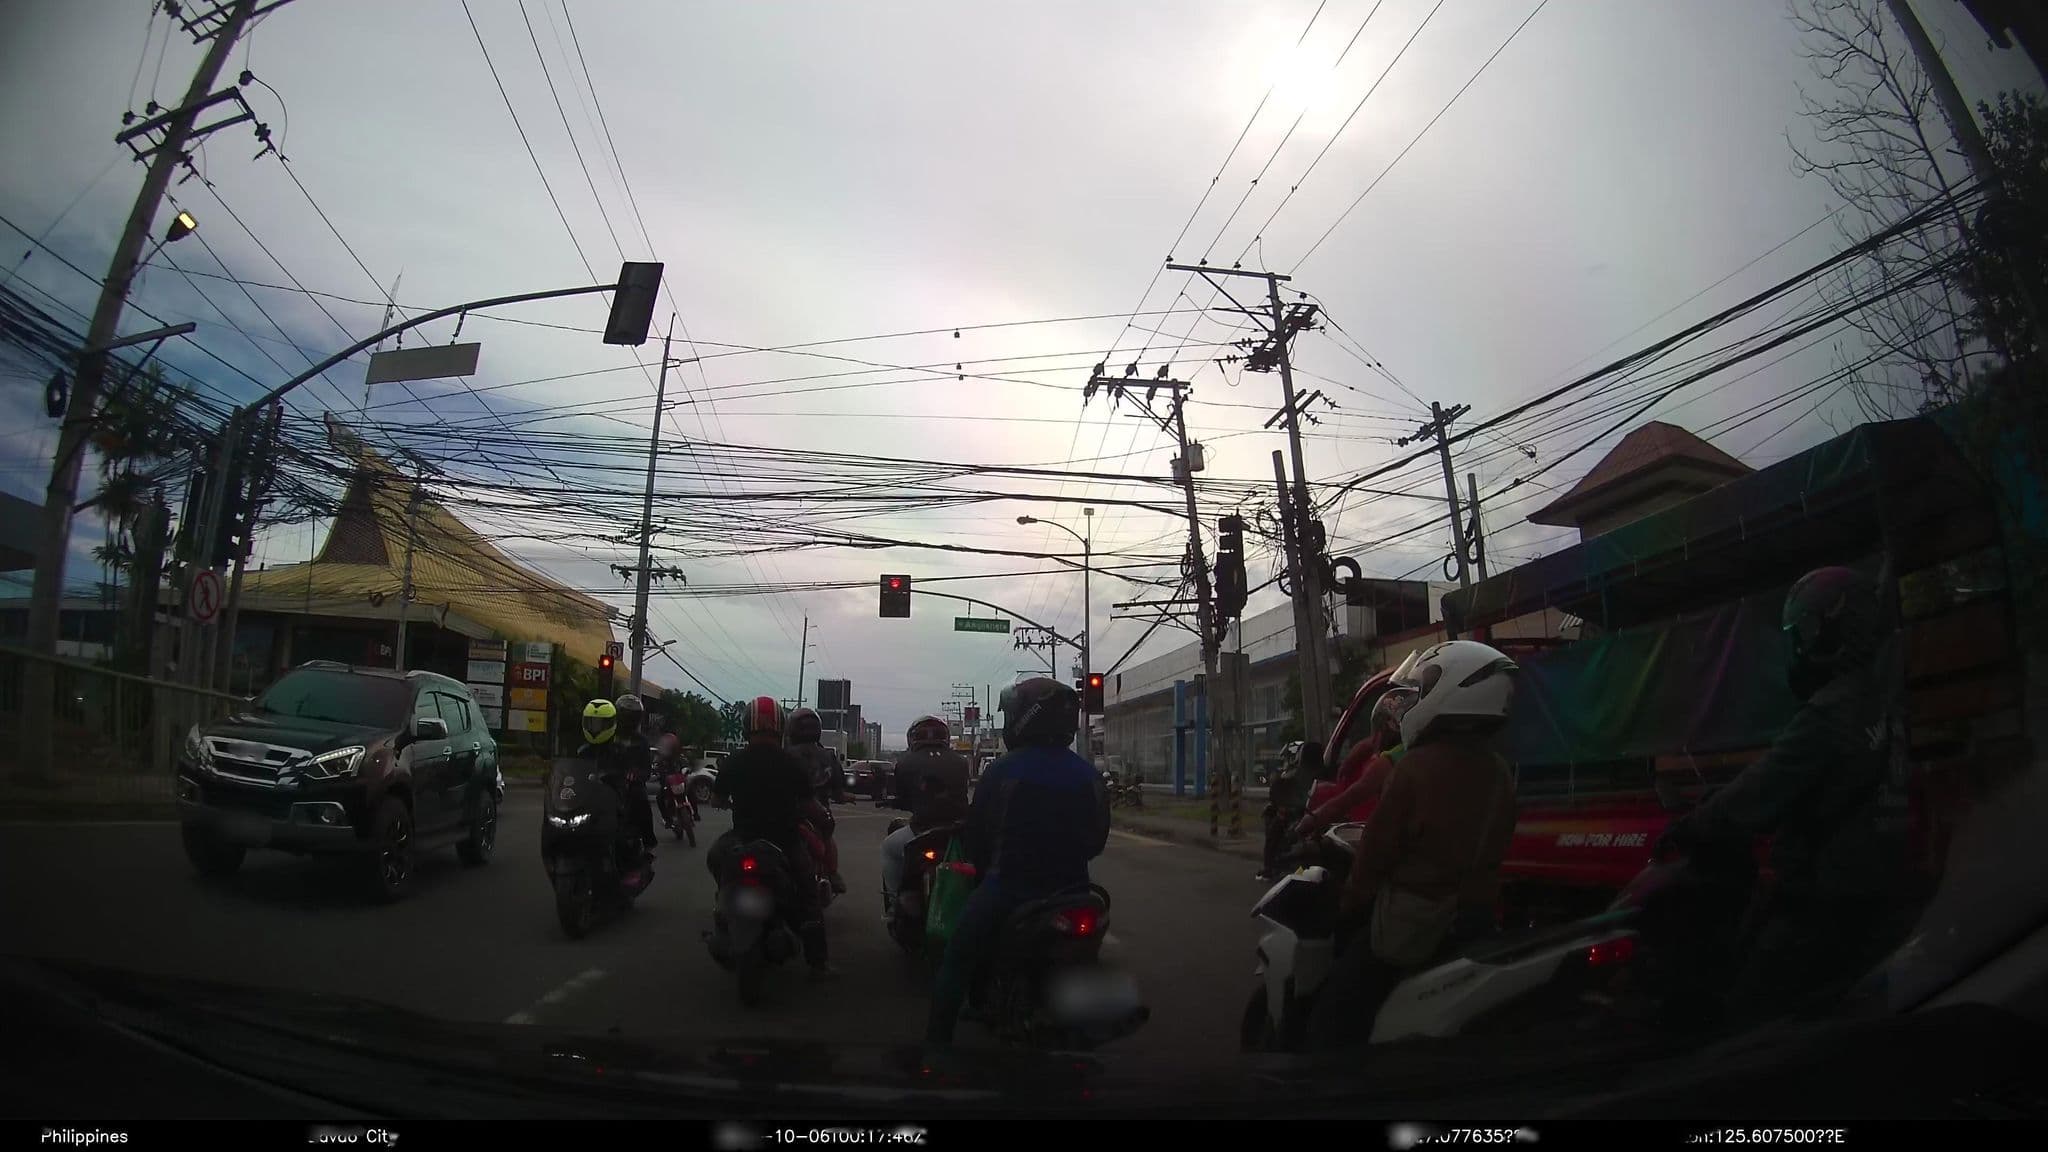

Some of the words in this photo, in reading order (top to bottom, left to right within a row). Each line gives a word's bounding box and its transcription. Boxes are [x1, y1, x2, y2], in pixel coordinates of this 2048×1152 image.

[523, 668, 546, 682] BPI
[1584, 832, 1613, 847] FOR
[1612, 832, 1648, 847] HIRE
